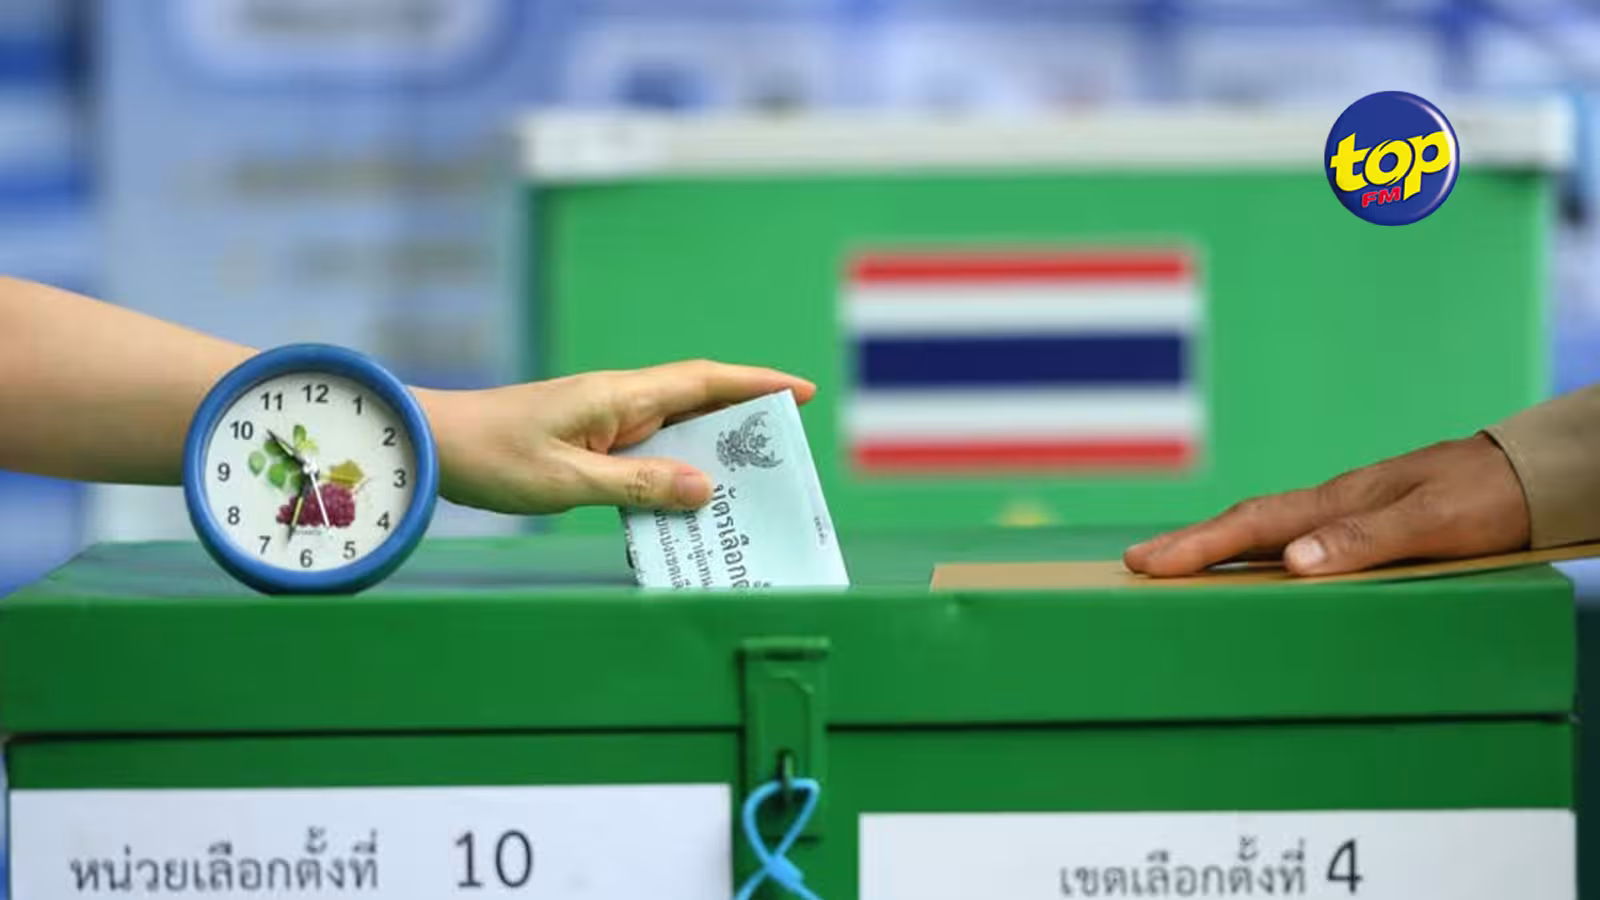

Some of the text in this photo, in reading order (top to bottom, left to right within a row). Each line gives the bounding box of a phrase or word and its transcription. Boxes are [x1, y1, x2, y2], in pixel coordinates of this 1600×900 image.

[261, 392, 283, 411] 11
[302, 384, 329, 403] 12
[353, 395, 362, 415] 1
[230, 421, 254, 440] 10
[383, 427, 397, 446] 2
[217, 462, 231, 481] 9
[393, 469, 407, 488] 3
[227, 506, 241, 525] 8
[377, 511, 390, 530] 4
[258, 535, 271, 554] 7
[343, 541, 356, 560] 5
[300, 549, 313, 568] 6
[70, 826, 533, 891] หน่วยเลือกตั้งที่ 10
[1059, 835, 1364, 897] เขตเลือกตั้งที่ 4
